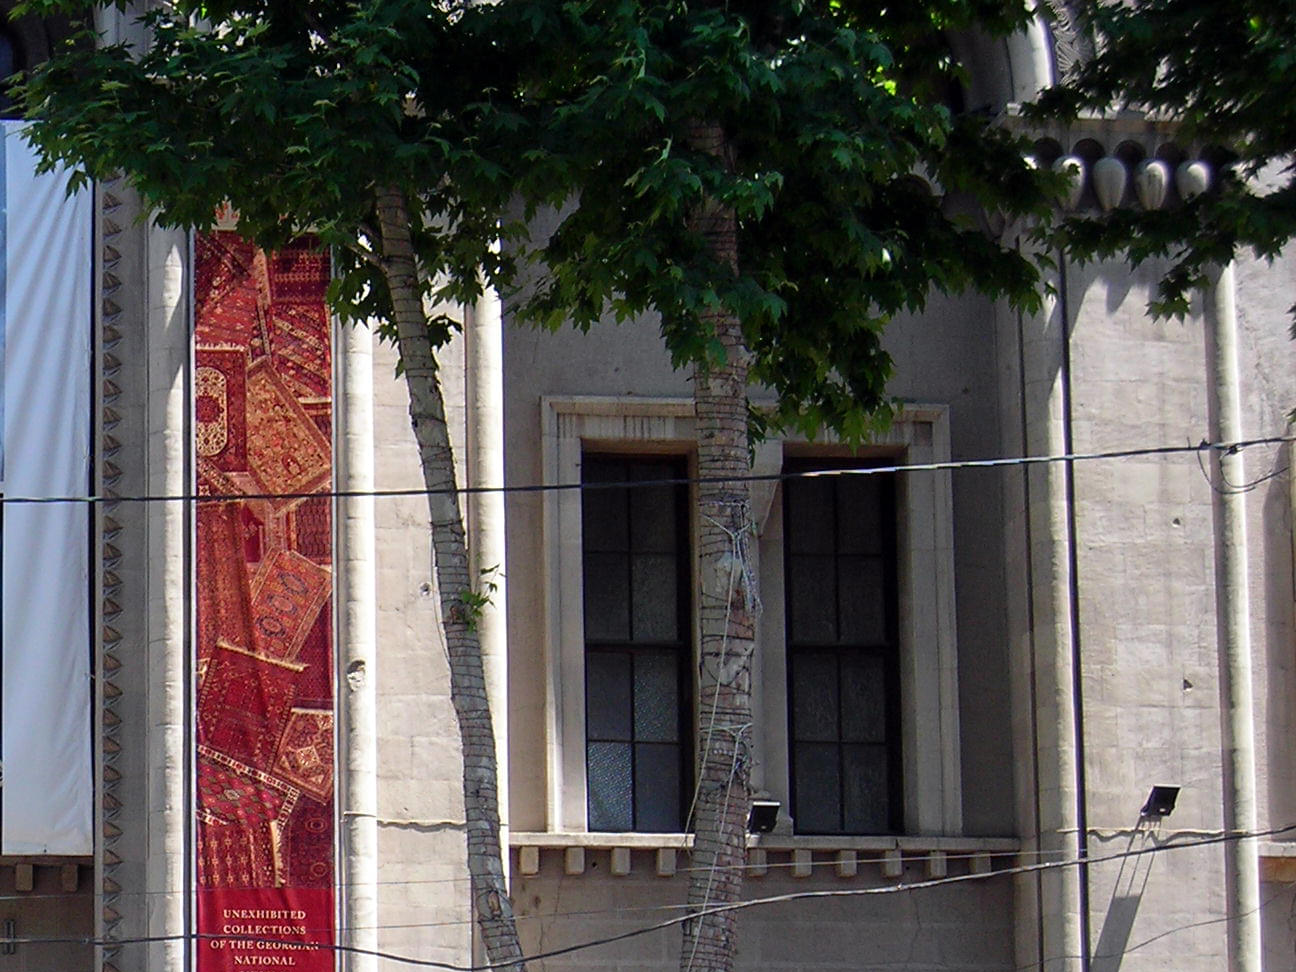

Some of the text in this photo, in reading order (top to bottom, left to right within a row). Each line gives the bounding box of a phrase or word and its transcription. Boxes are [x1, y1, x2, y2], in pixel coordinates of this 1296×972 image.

[223, 909, 306, 919] UNEXHIBITED
[223, 926, 306, 934] COLLECTIONS
[210, 940, 227, 949] OF
[229, 940, 254, 949] THE
[234, 956, 296, 965] NATIONAL
